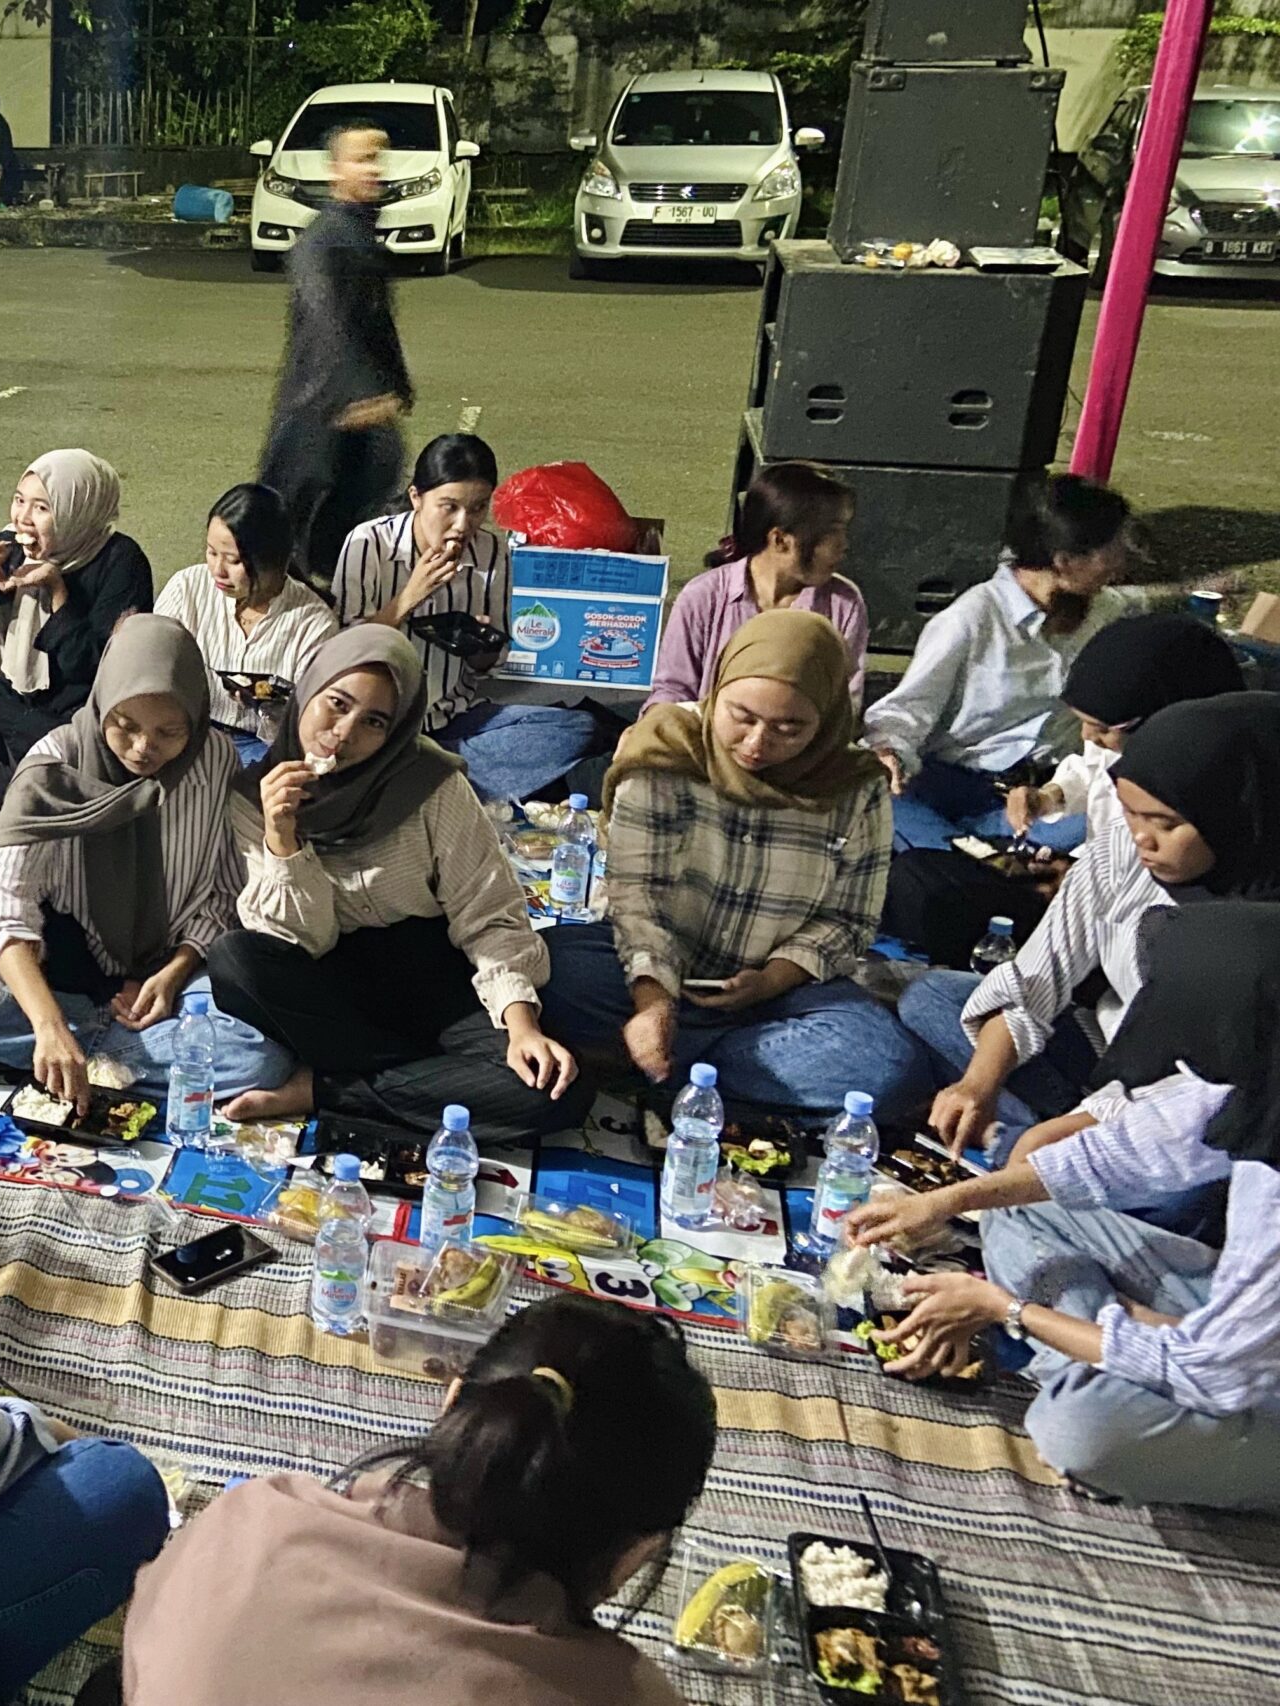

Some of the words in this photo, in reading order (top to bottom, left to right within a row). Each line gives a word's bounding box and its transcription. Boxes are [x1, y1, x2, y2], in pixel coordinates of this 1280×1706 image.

[654, 206, 661, 217] F
[672, 206, 693, 217] 1567
[1252, 241, 1274, 253] KRT
[531, 619, 542, 628] Le
